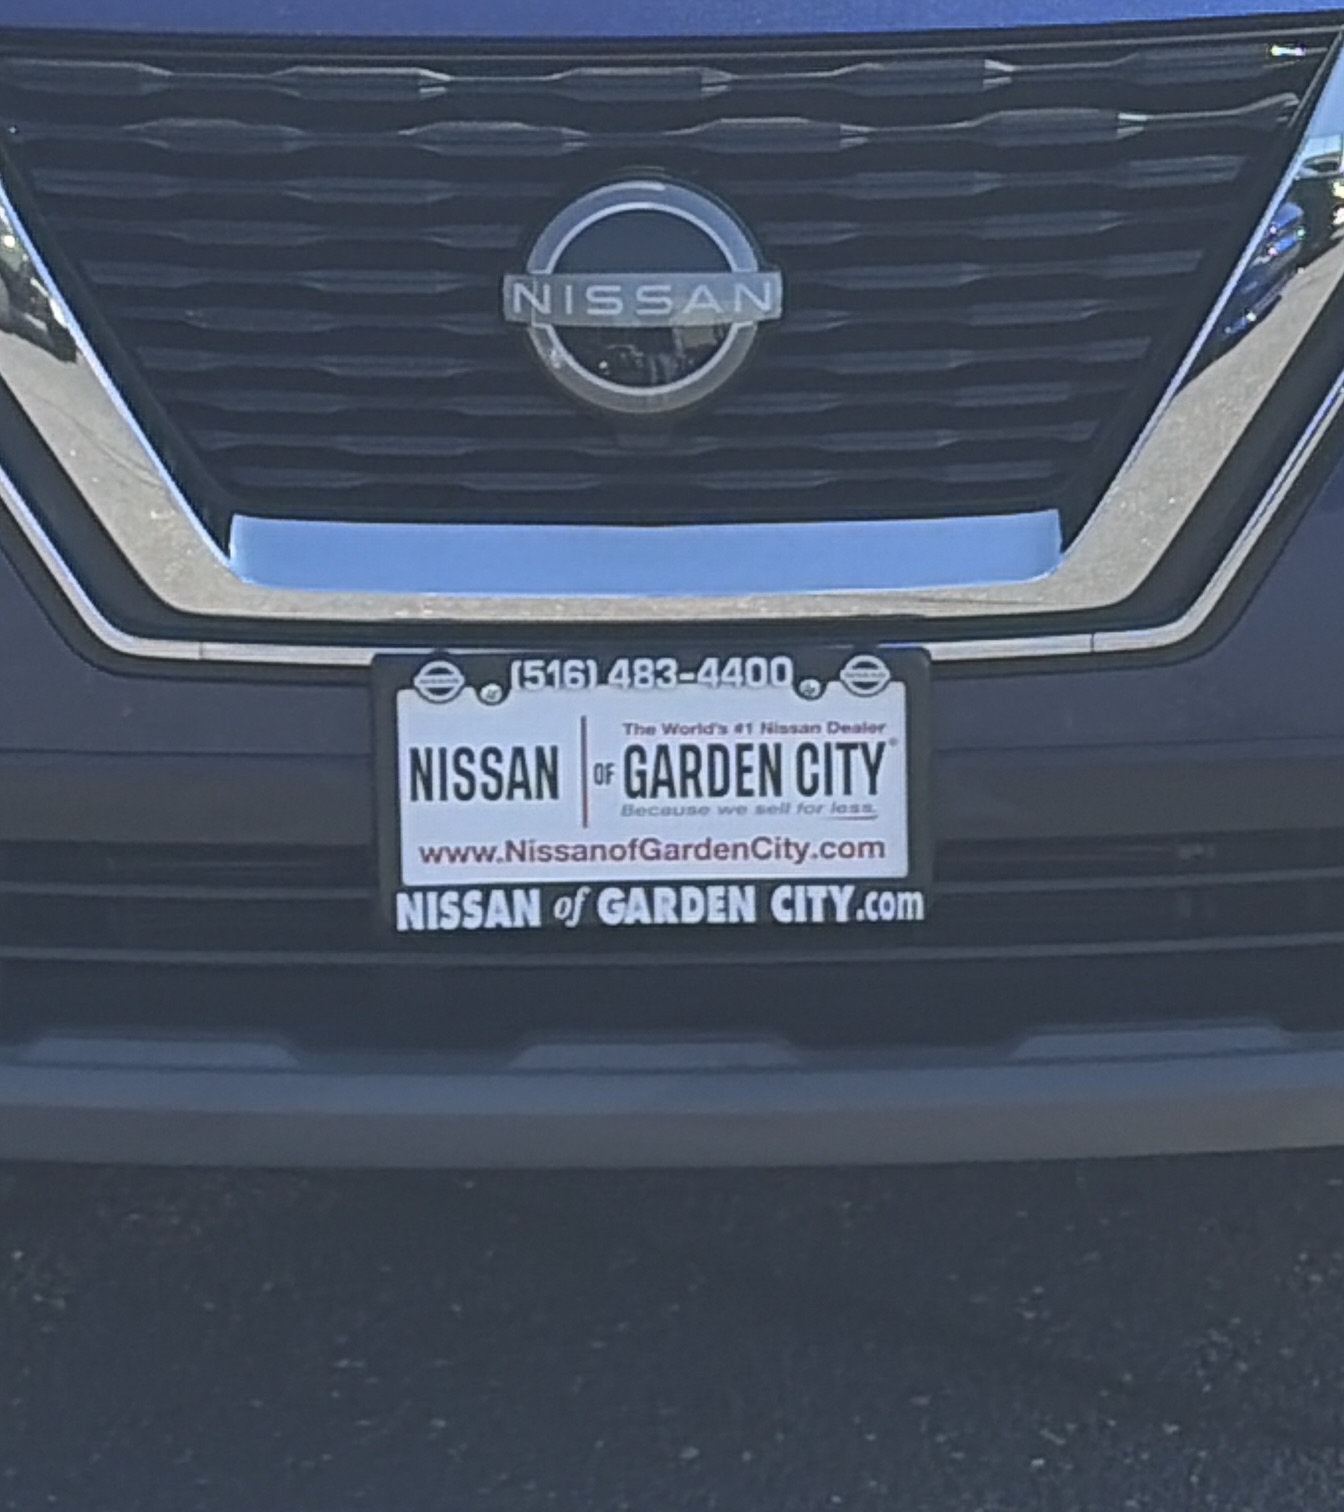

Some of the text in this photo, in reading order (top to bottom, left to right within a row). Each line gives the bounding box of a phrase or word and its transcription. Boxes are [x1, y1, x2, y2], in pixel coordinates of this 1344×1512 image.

[512, 281, 771, 316] NISSAN
[510, 655, 794, 689] (516) 483-4400
[623, 720, 887, 737] The World's #1 Nissan Dealer
[409, 740, 887, 802] NISSAN OF GARDEN CITY
[620, 802, 710, 818] Because
[717, 805, 748, 816] we
[754, 801, 790, 816] sell
[796, 801, 824, 816] for
[418, 836, 886, 865] www.NissanofGardenCity.com
[395, 884, 925, 931] NISSAN of GARDEN CITY.com
